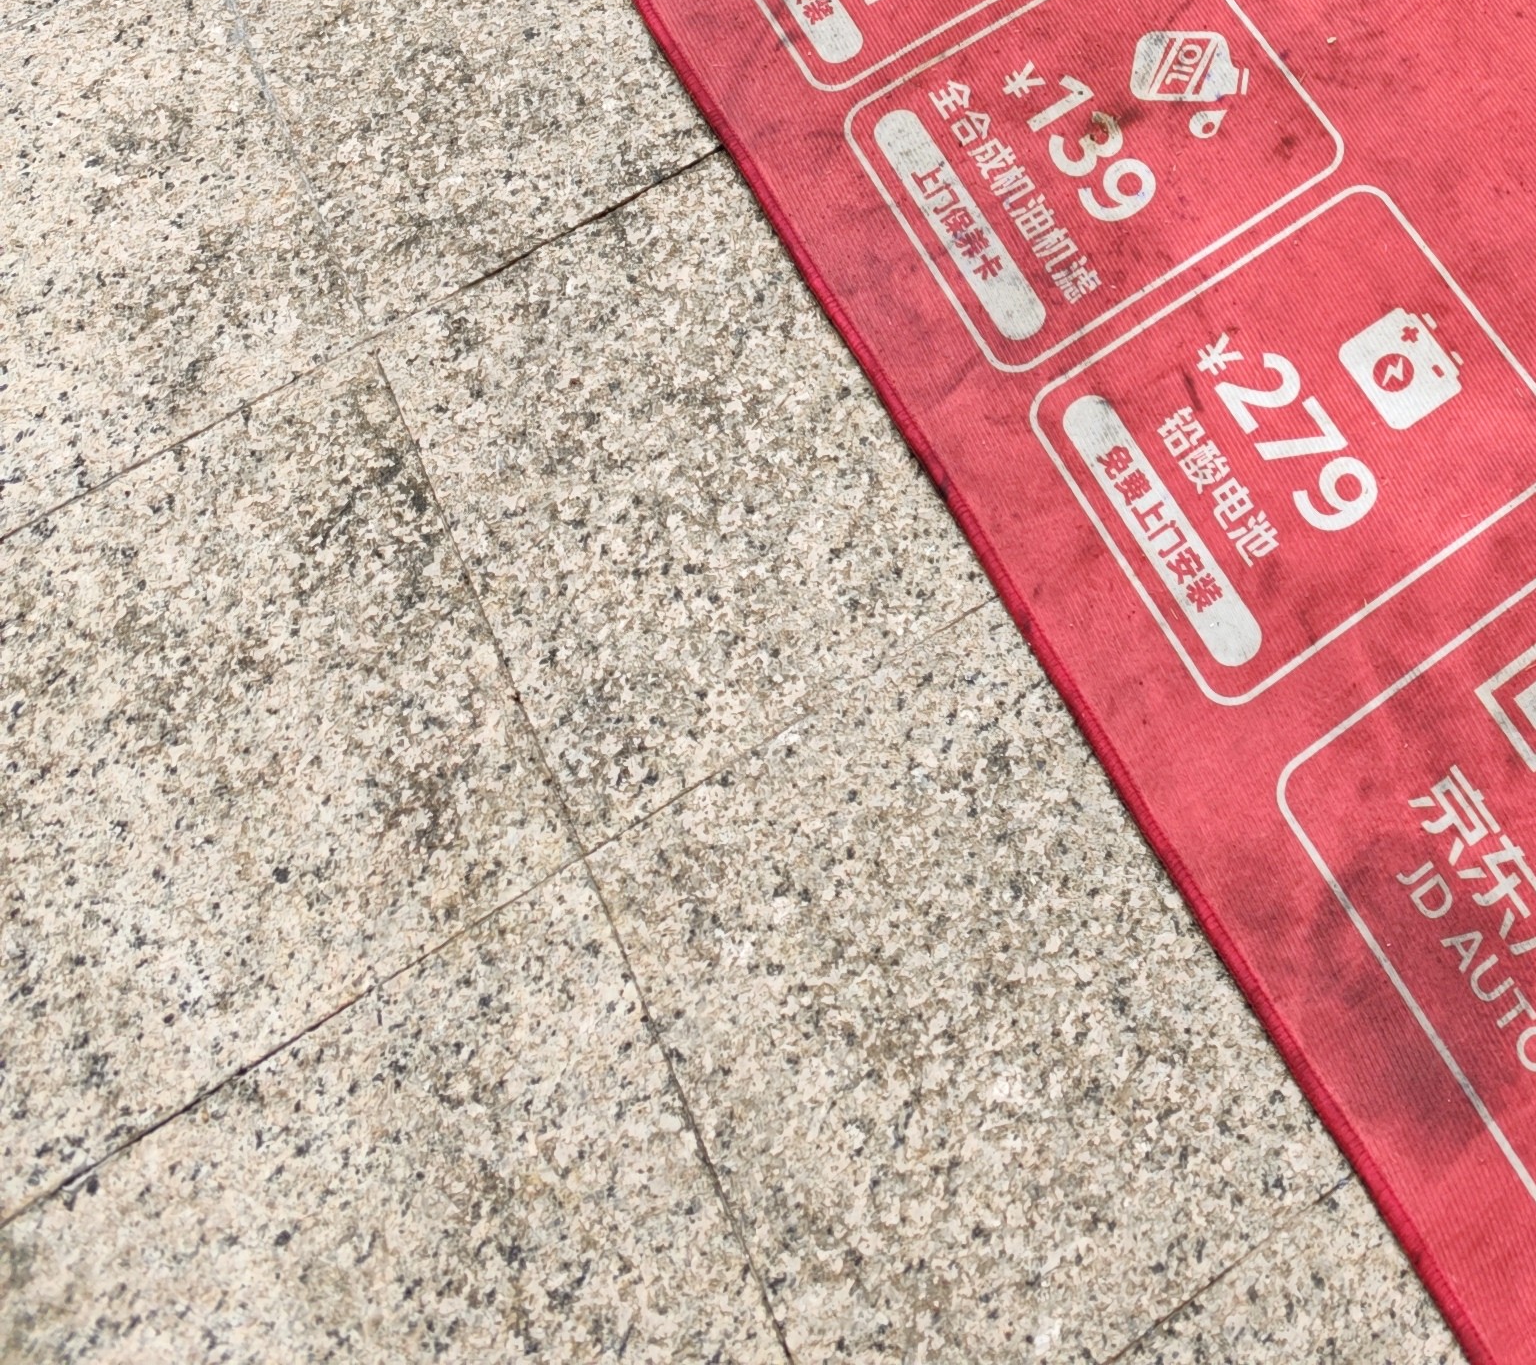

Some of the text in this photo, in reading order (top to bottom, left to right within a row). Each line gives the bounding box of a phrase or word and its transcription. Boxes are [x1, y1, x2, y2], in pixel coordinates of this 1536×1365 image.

[1002, 61, 1157, 222] ¥139
[1165, 44, 1202, 85] OIL
[911, 165, 1004, 281] 上门保养卡
[928, 79, 1102, 304] 全合成机油机滤
[1157, 406, 1280, 567] 铅酸电池
[1196, 332, 1379, 532] ¥279
[1096, 445, 1223, 612] 免费上门安装
[1396, 861, 1454, 919] JD
